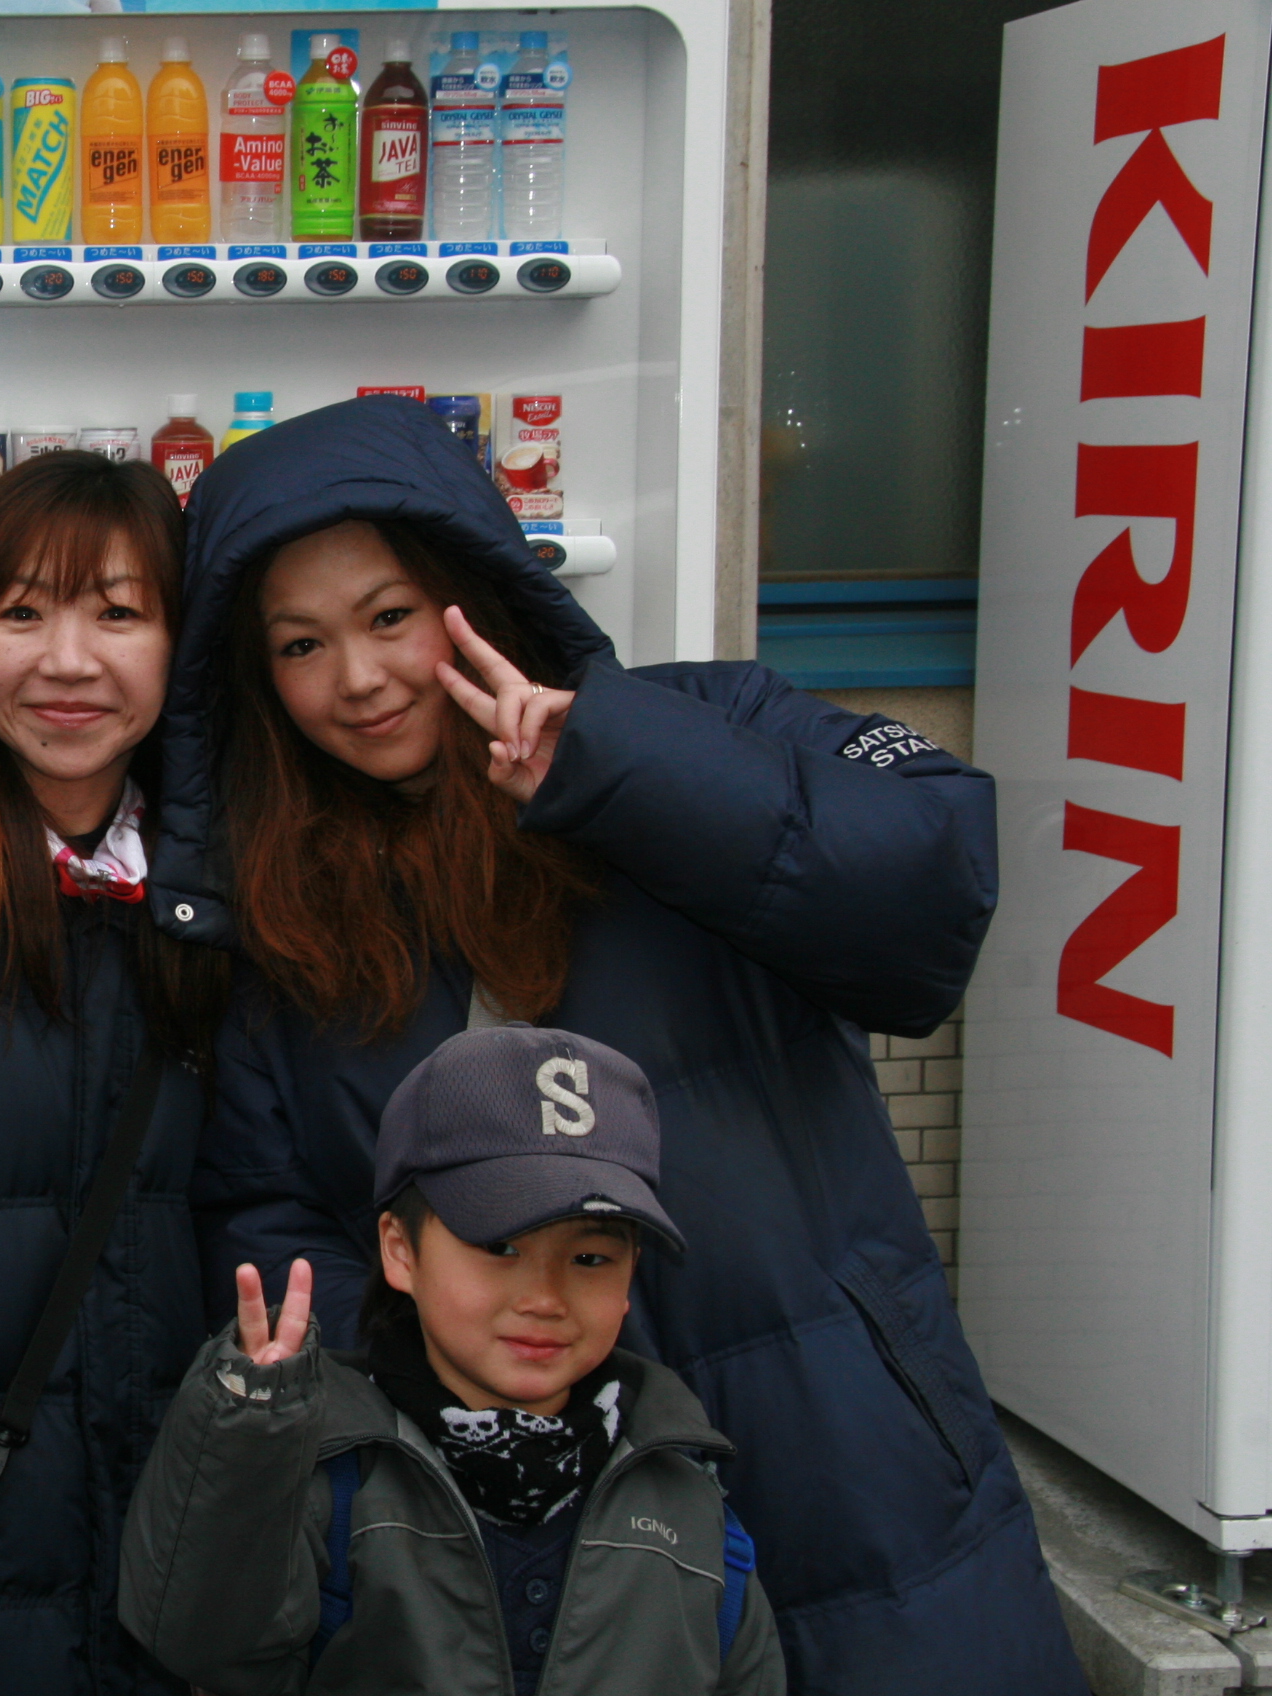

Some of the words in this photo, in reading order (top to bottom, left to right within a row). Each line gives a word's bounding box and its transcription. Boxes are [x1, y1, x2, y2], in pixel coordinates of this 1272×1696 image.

[25, 90, 50, 107] BIG
[234, 137, 283, 153] Amino
[379, 133, 417, 164] JAVA
[16, 110, 69, 220] MATCH
[91, 150, 135, 167] ener
[159, 148, 202, 166] ener
[103, 158, 137, 185] gen
[171, 155, 204, 183] gen
[44, 273, 63, 284] 120
[115, 273, 133, 284] 150
[187, 272, 204, 283] 150
[328, 270, 346, 281] 150
[170, 461, 200, 482] JAVA
[537, 547, 556, 558] 120
[1056, 33, 1226, 1058] KIRIN
[535, 1057, 596, 1136] S
[631, 1516, 677, 1545] IGNIO
